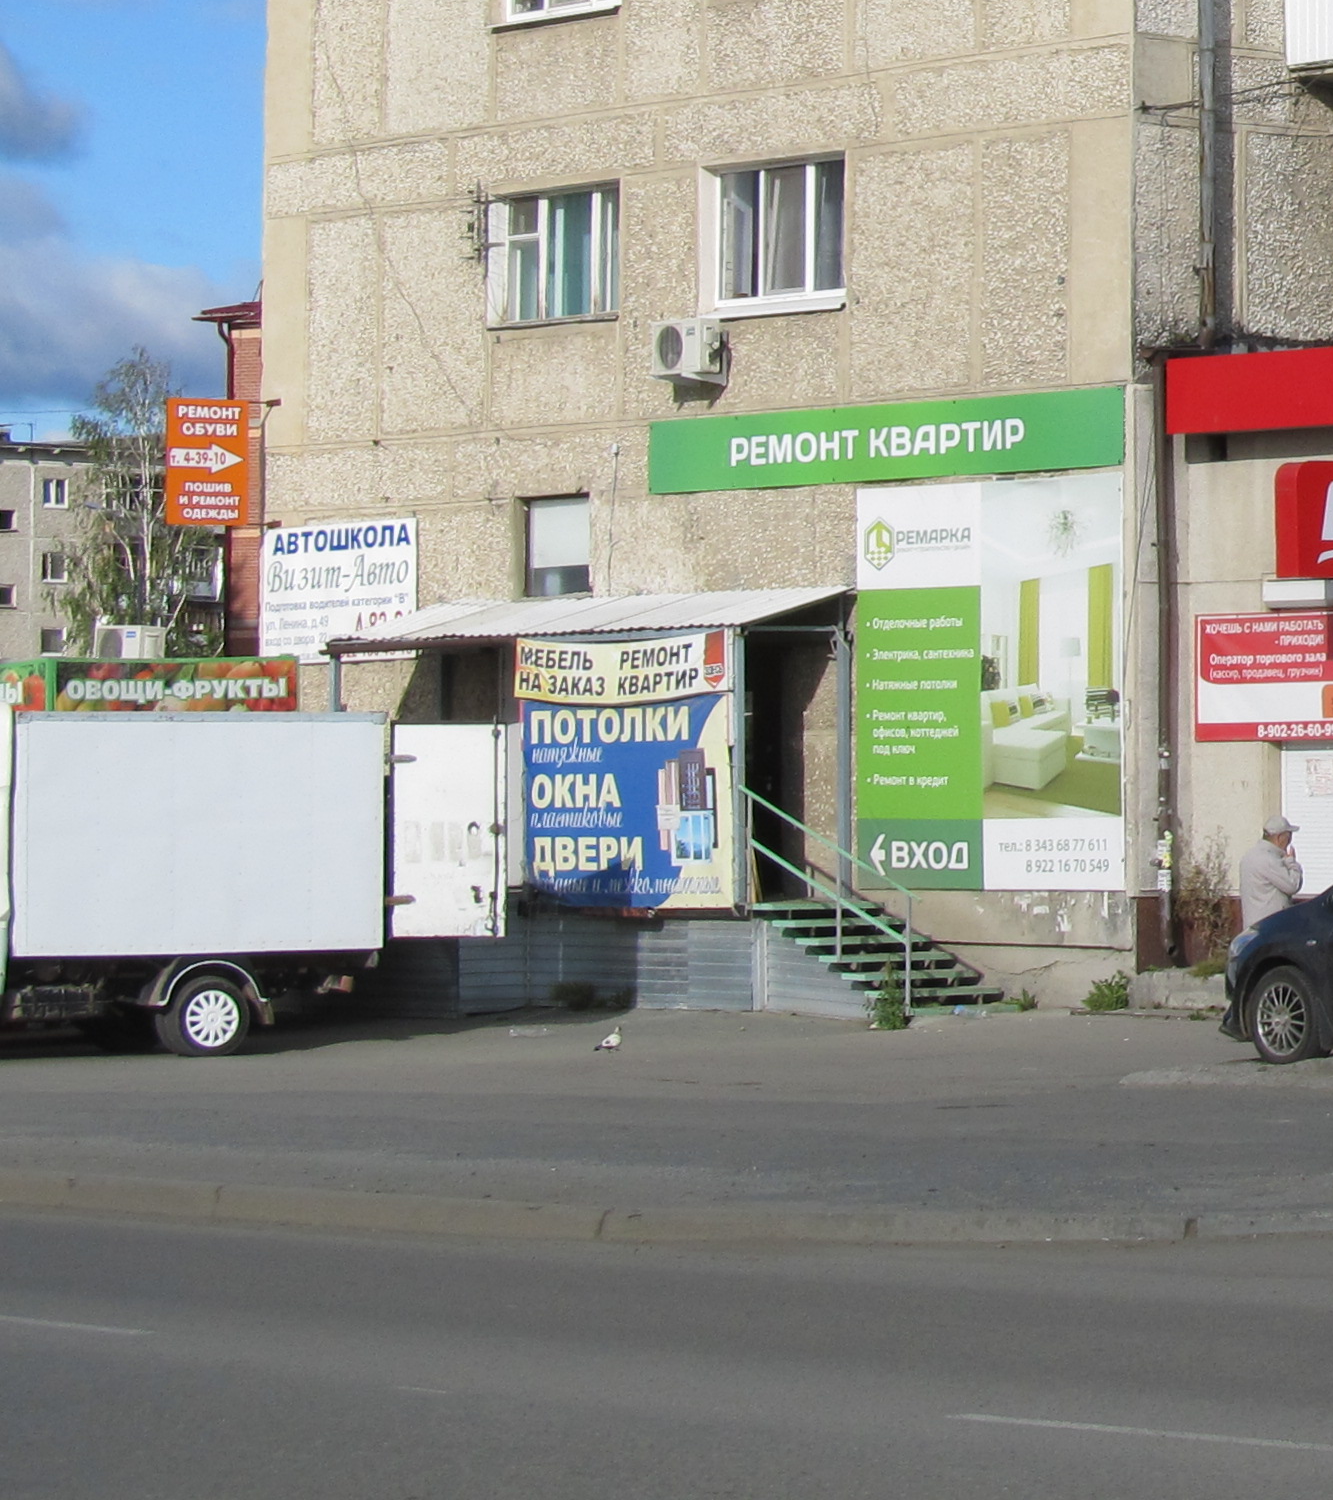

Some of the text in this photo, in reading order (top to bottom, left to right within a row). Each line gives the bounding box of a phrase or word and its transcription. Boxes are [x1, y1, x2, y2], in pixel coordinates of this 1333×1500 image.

[178, 405, 242, 420] РЕМОНТ
[182, 422, 238, 437] ОБУВИ
[729, 417, 1026, 467] РЕМОНТ КВАРТИР
[184, 452, 227, 465] 4-39-10
[184, 482, 233, 493] ПОШИВ
[179, 496, 240, 506] И РЕМОНТ
[182, 508, 239, 520] ОДЕЖДЫ
[272, 523, 411, 556] АВТОШКОЛА
[896, 527, 971, 546] РЕМАРКА
[267, 553, 410, 593] Визит-Авто
[265, 601, 308, 613] Подготовка
[351, 596, 393, 608] категории
[872, 615, 963, 630] Отделочные работы
[1205, 623, 1242, 634] ХОЧЕШЬ
[1252, 621, 1278, 633] НАМИ
[1279, 619, 1324, 632] РАБОТАТЬ
[520, 646, 594, 671] МЕБЕЛЬ
[619, 643, 692, 671] РЕМОНТ
[872, 648, 974, 663] Электрика, сантехника
[1209, 653, 1253, 667] Оператор
[1255, 653, 1302, 666] торгового
[1304, 651, 1327, 662] зала
[1242, 666, 1285, 679] продавец,
[519, 670, 605, 697] НА ЗАКАЗ
[617, 667, 699, 697] КВАРТИР
[872, 679, 957, 691] Натяжные потолки
[66, 678, 288, 704] ОВОЩИ-ФРУКТЫ
[872, 709, 947, 722] Ремонт квартир,
[530, 706, 690, 745] ПОТОЛКИ
[872, 725, 959, 739] офисов, коттеджей
[531, 736, 603, 768] натяжные
[872, 744, 916, 755] под ключ
[873, 773, 907, 786] Ремонт
[916, 775, 949, 788] кредит
[531, 773, 622, 809] ОКНА
[530, 801, 624, 829] пластиковые
[1025, 838, 1032, 852] 8
[1034, 838, 1054, 852] 343
[1056, 838, 1070, 852] 68
[1072, 838, 1085, 852] 77
[1088, 838, 1108, 852] 611
[532, 836, 644, 877] ДВЕРИ
[891, 840, 969, 870] ВХОД
[1025, 858, 1110, 873] 8 922 16 70 549
